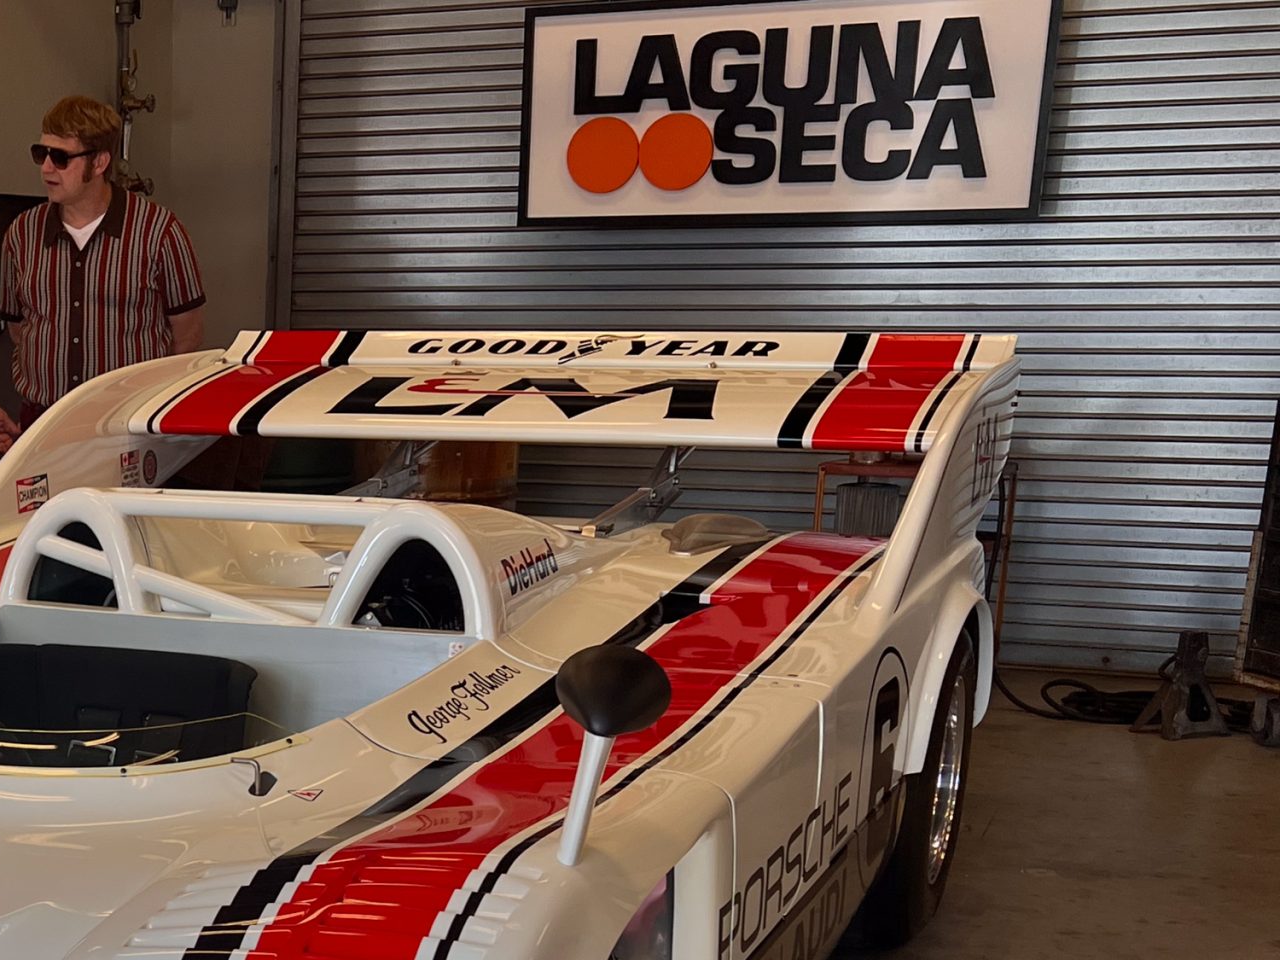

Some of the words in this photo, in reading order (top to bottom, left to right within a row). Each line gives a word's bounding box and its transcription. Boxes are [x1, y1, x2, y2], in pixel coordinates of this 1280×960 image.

[574, 16, 995, 115] LAGUNA
[711, 97, 987, 185] SECA
[408, 338, 567, 355] GOOD
[625, 340, 780, 357] YEAR
[19, 486, 47, 502] CHAMPION
[500, 538, 559, 596] DieHard
[407, 694, 471, 744] George
